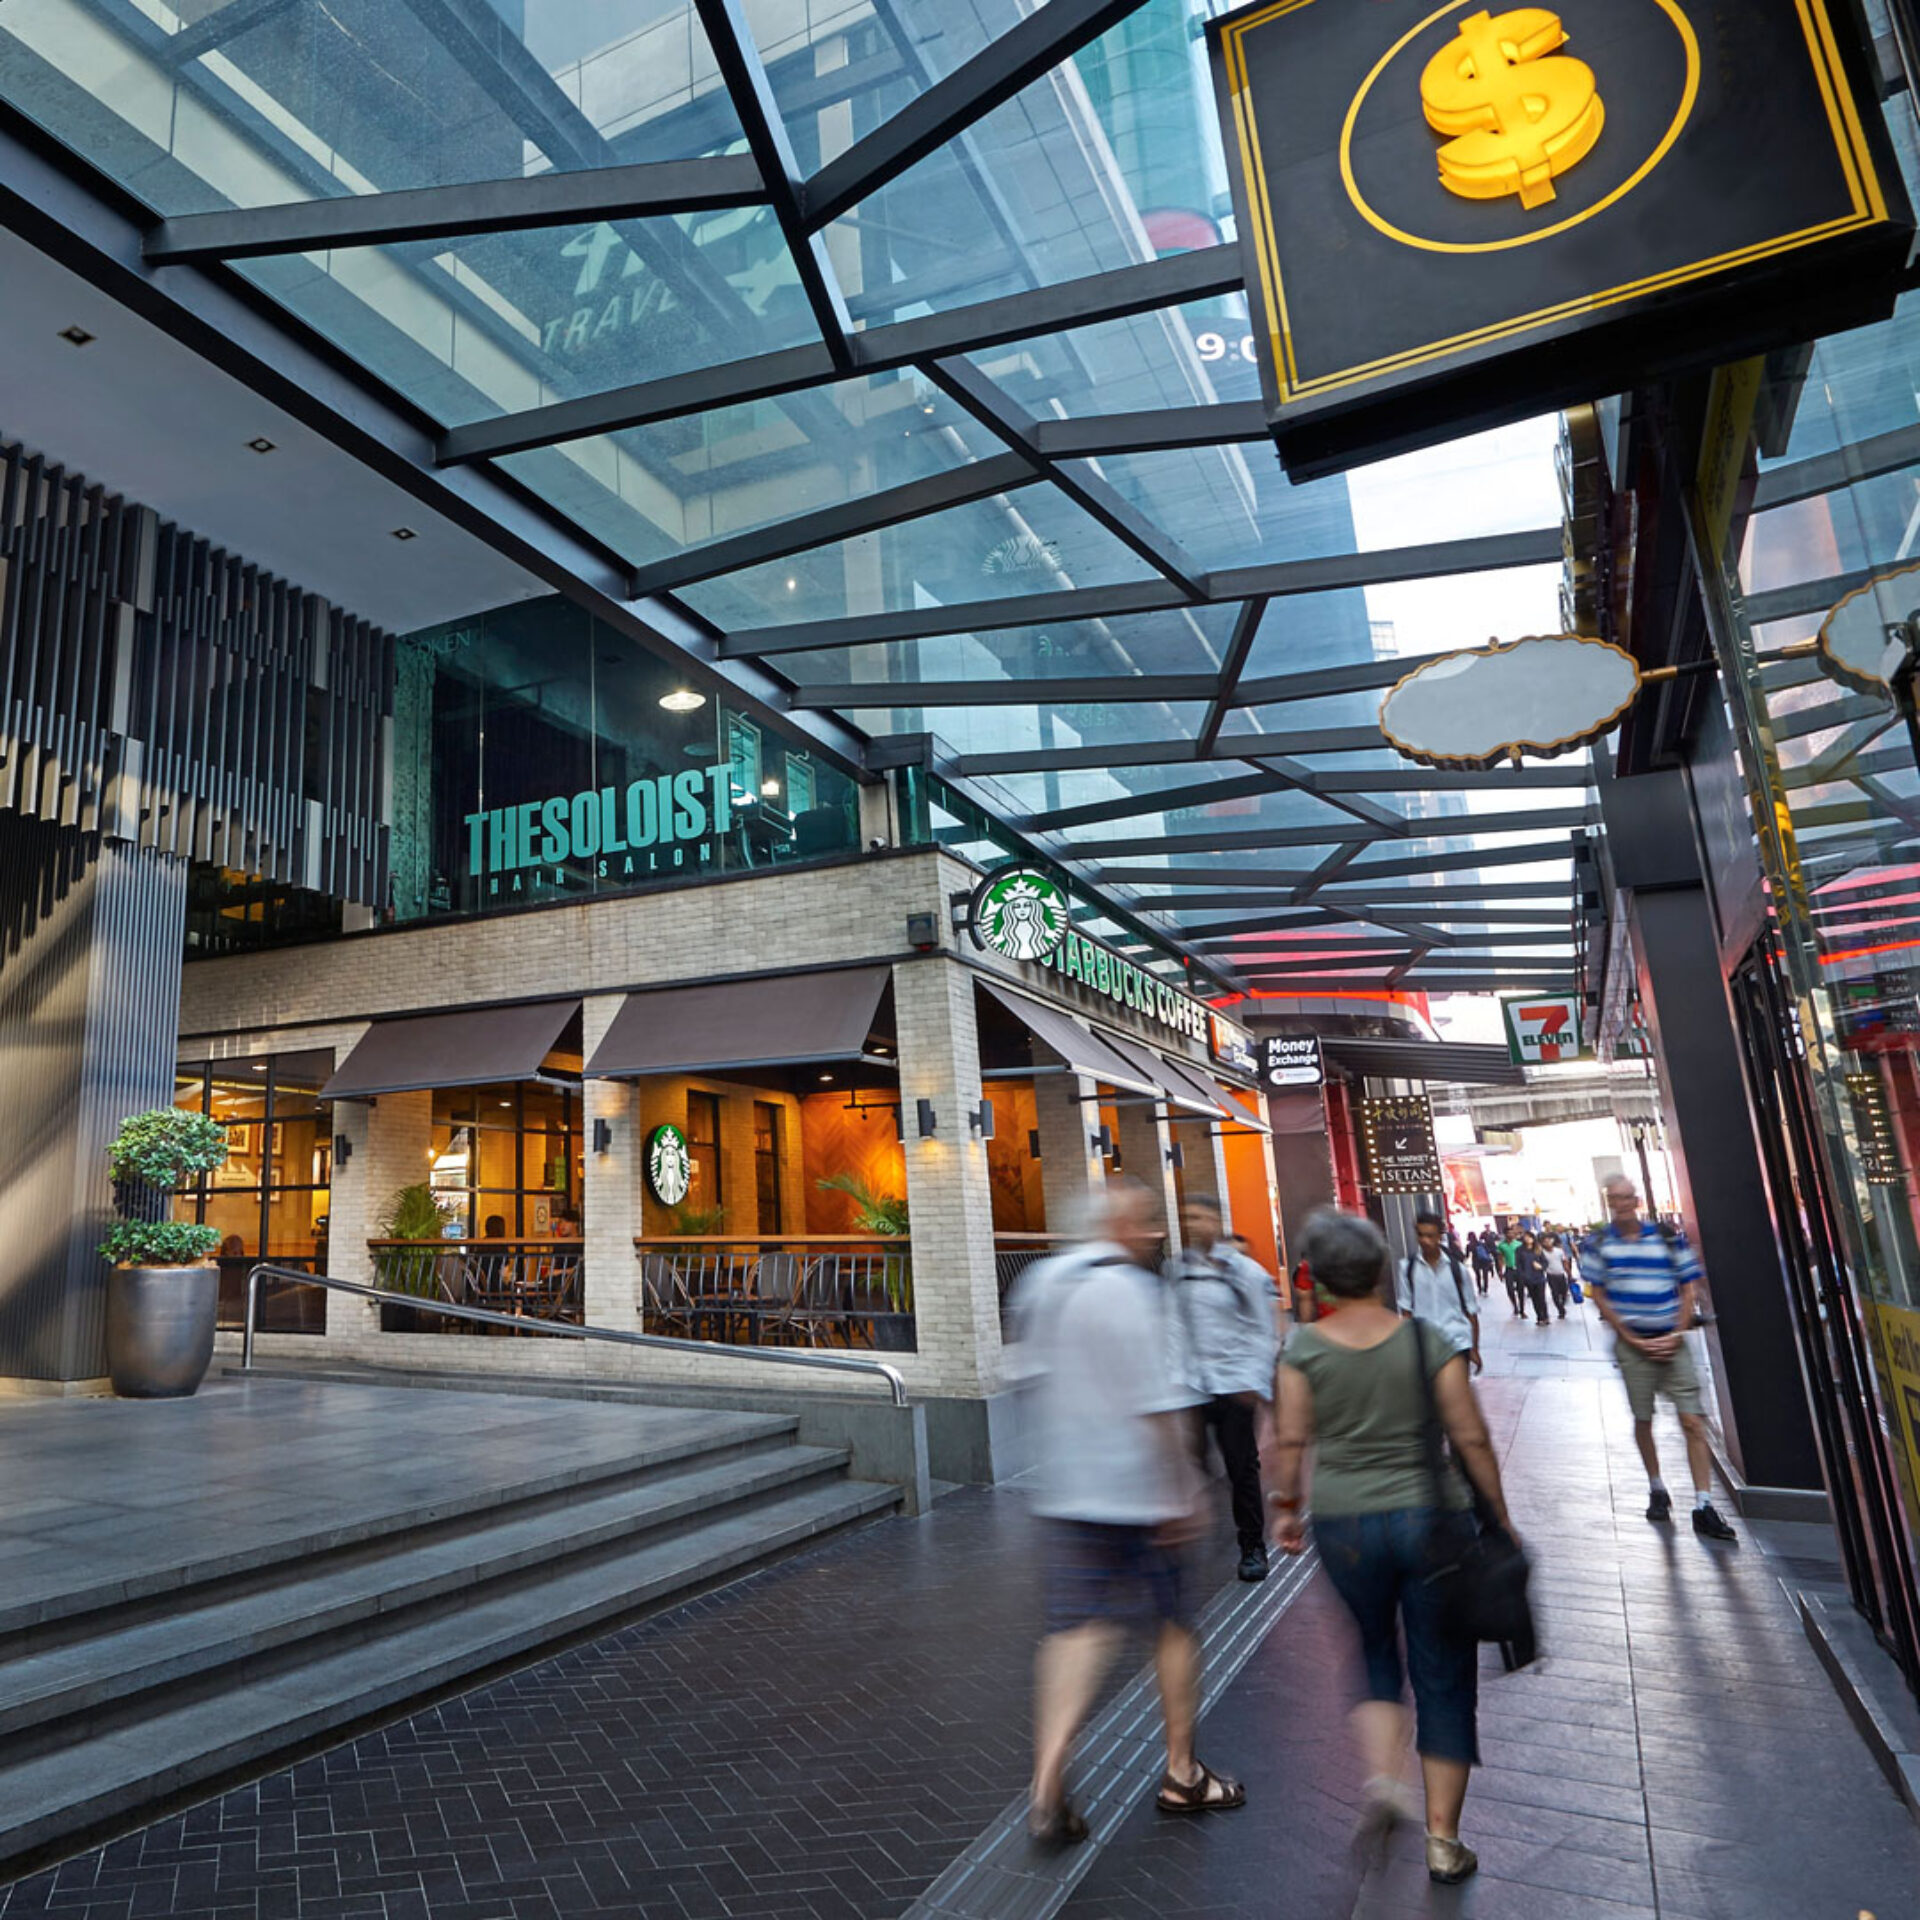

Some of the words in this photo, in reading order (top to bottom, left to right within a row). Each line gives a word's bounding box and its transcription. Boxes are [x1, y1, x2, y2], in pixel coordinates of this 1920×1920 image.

[598, 842, 711, 878] SALON
[490, 867, 565, 895] HAIR
[1156, 981, 1208, 1045] COFFEE
[1268, 1038, 1316, 1054] Money
[1519, 1005, 1570, 1062] 7
[1268, 1053, 1319, 1068] Exchange
[1381, 1168, 1433, 1181] ISETAN
